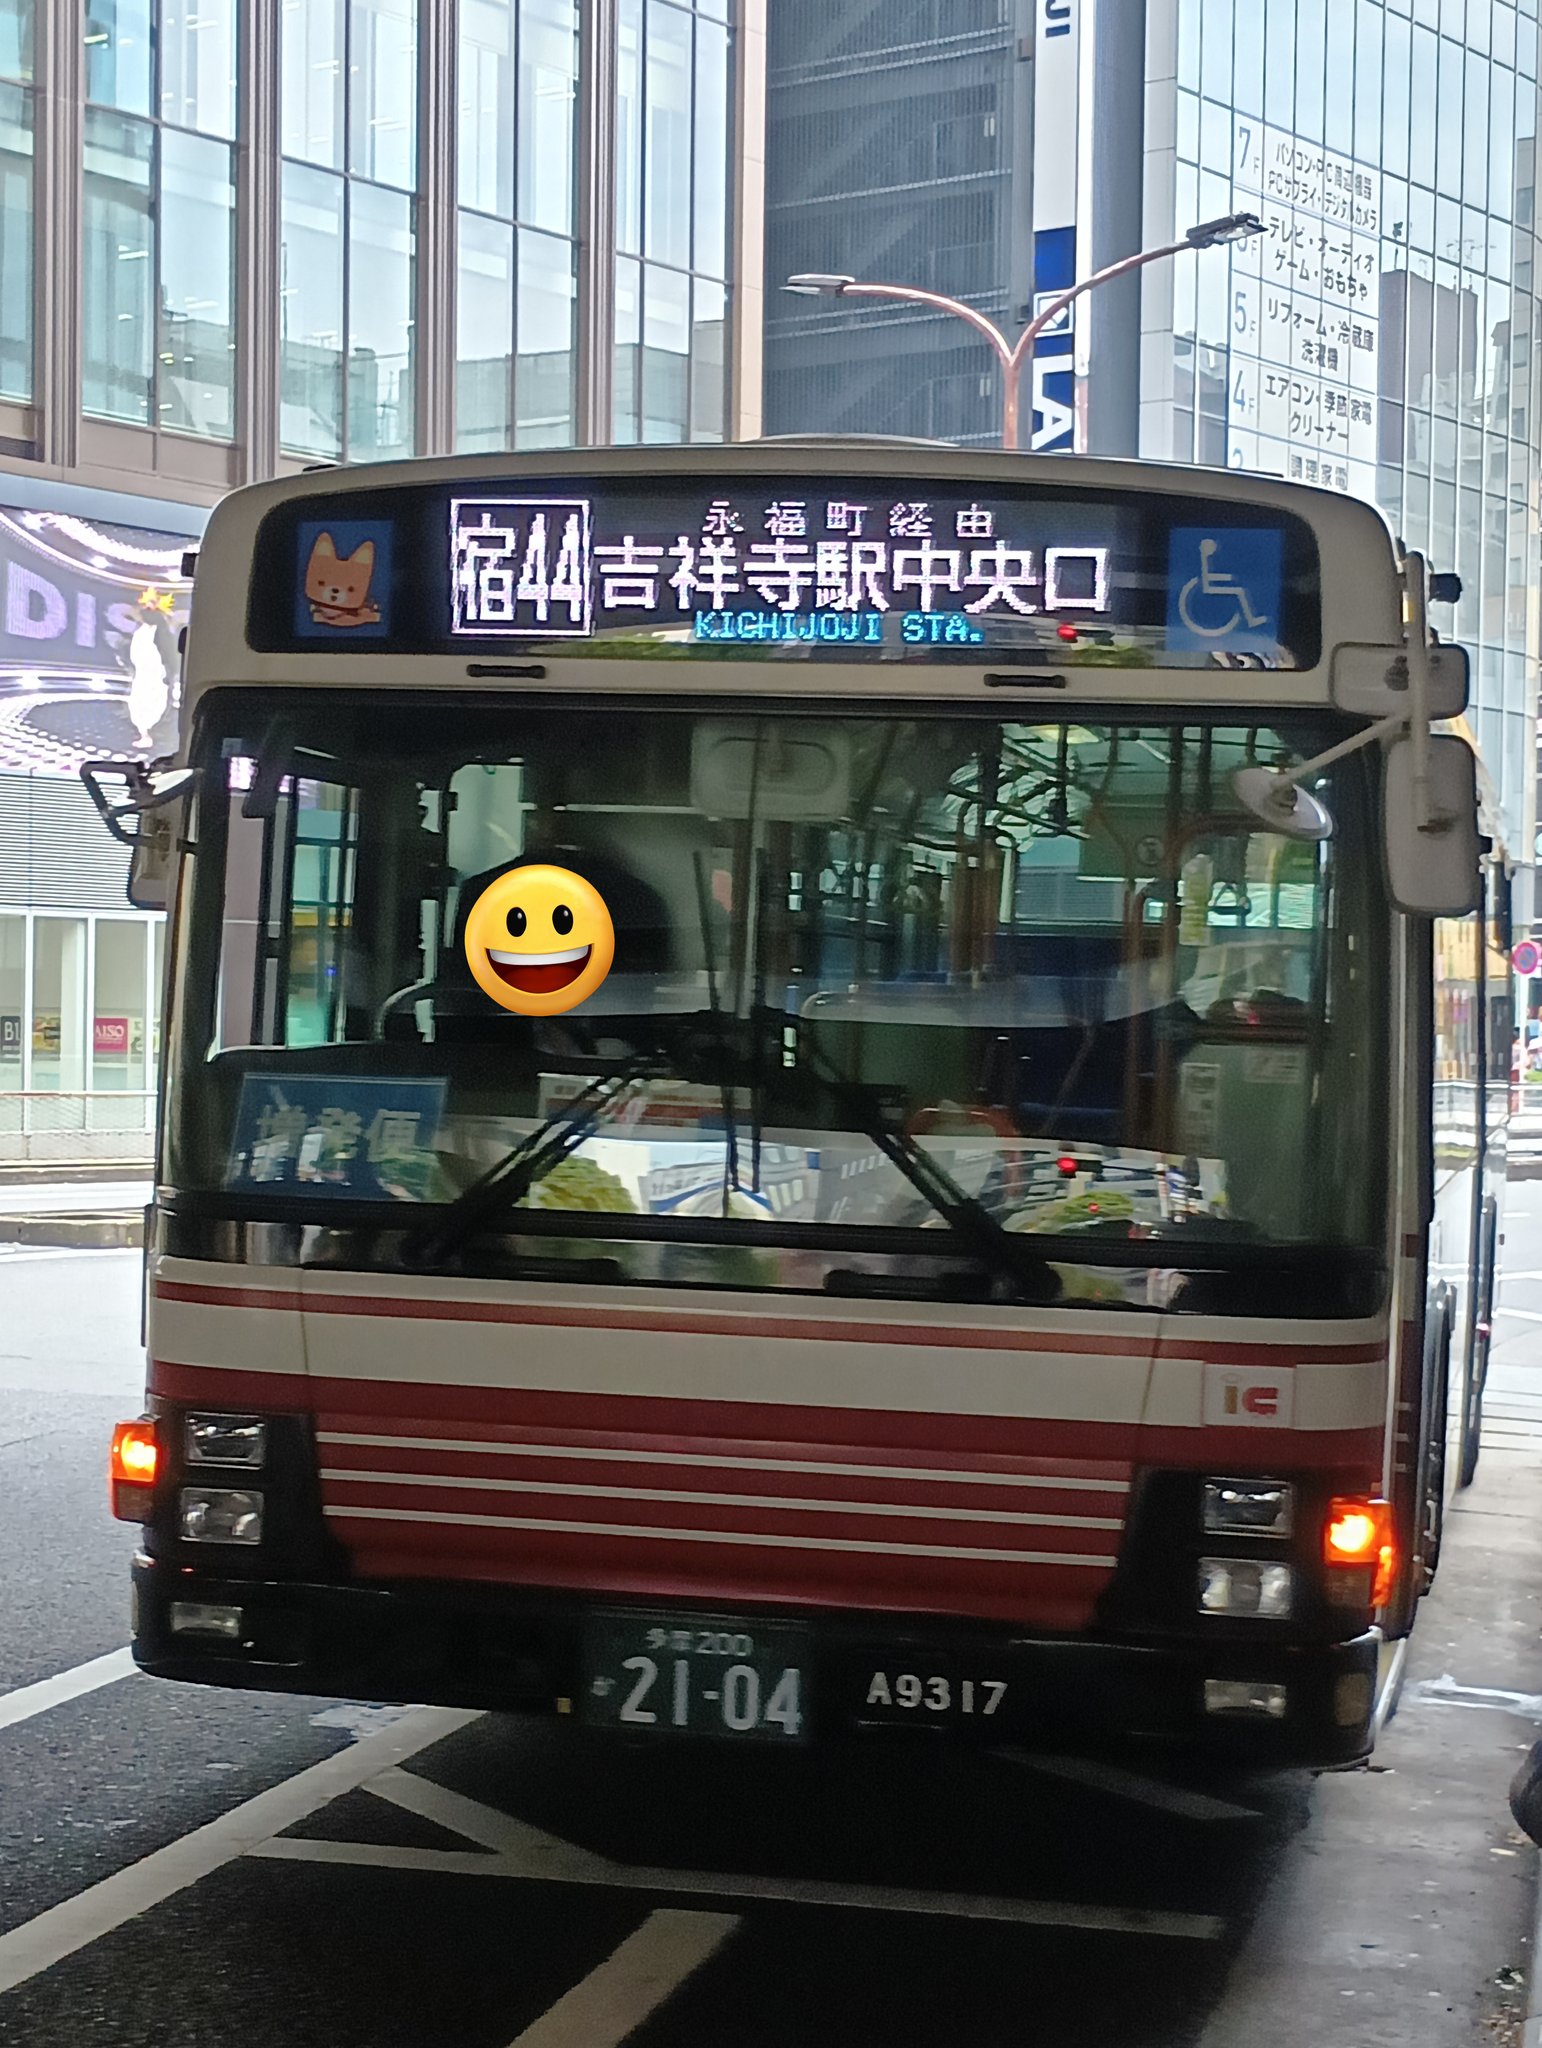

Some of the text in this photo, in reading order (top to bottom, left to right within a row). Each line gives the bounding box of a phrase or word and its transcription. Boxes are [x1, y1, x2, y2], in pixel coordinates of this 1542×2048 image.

[1275, 249, 1368, 301] ゲーム・おもちゃ
[1031, 354, 1073, 453] LA
[1289, 411, 1349, 442] クリーナー
[1291, 454, 1348, 491] 調理家電
[701, 500, 995, 538] 永福町経由
[593, 535, 1111, 614] 吉祥寺駅中央口
[694, 610, 985, 643] KICHIJOJI STA.
